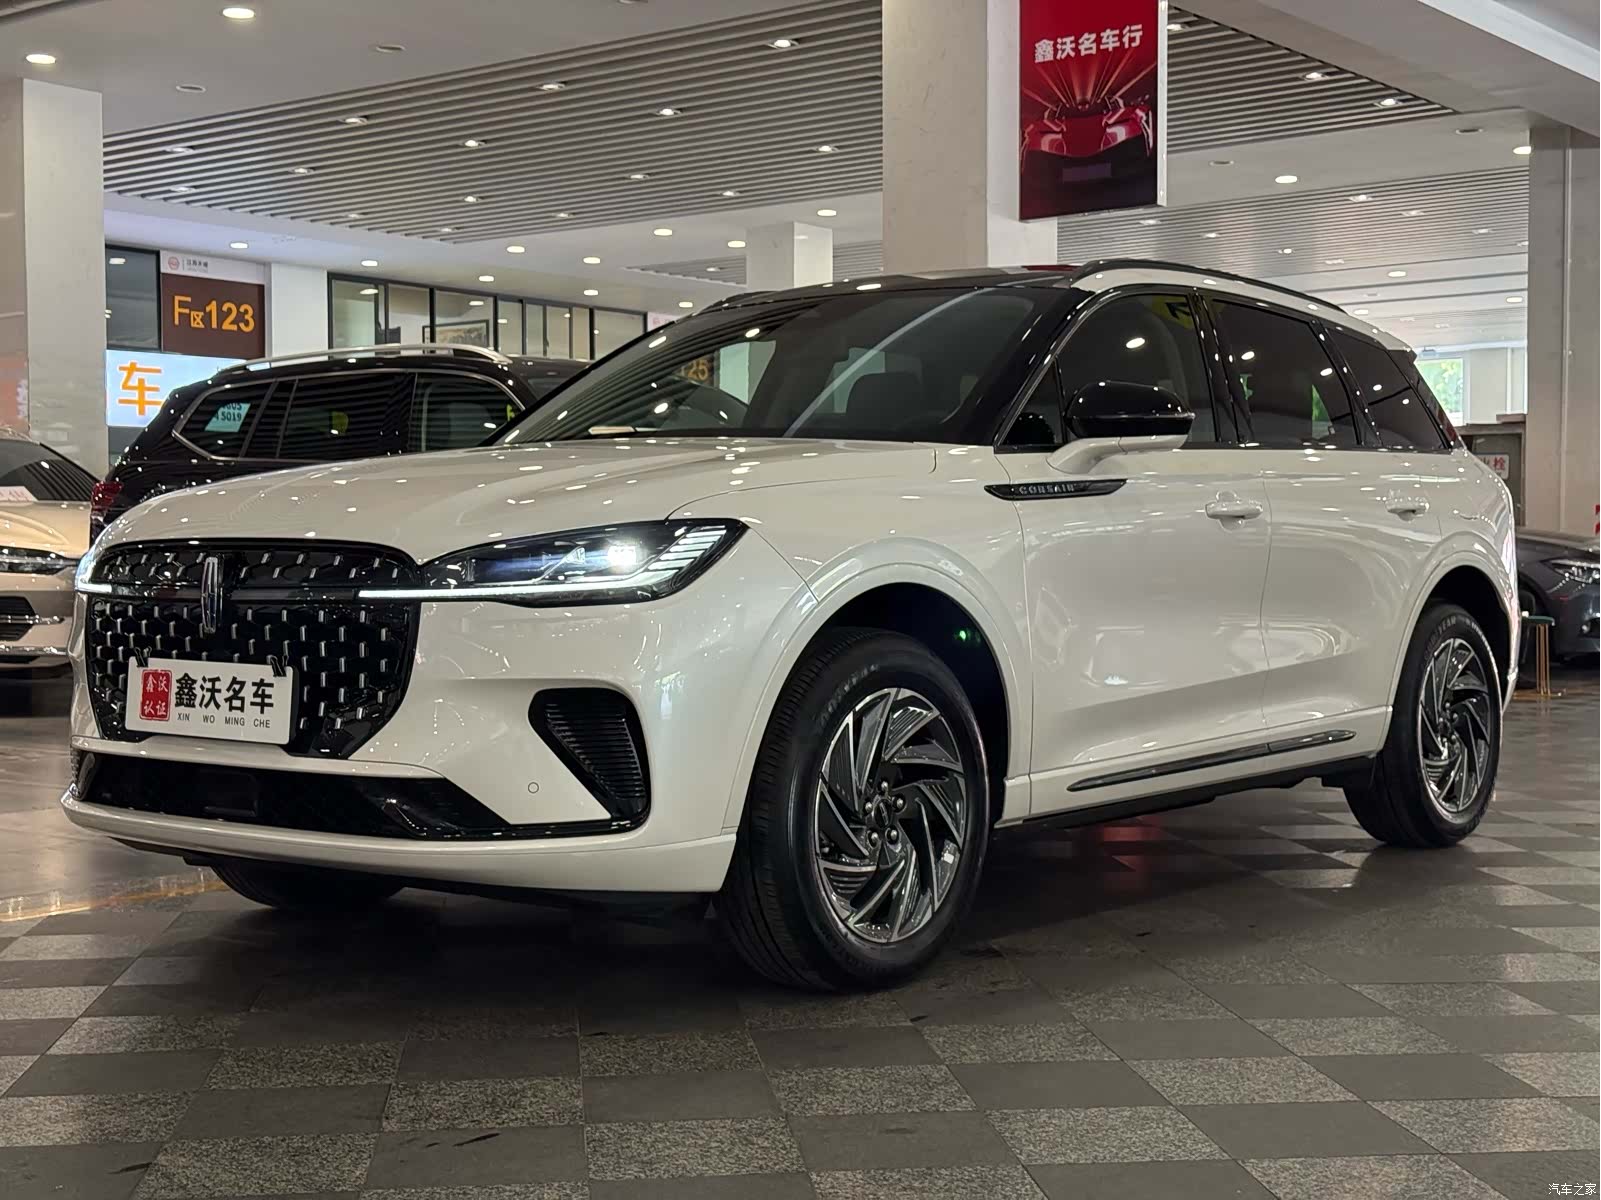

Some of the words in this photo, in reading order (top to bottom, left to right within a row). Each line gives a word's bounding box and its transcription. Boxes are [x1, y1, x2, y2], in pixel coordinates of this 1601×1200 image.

[1034, 24, 1143, 64] 鑫沃名车行
[172, 294, 255, 333] F区123
[118, 361, 162, 416] 车
[1018, 484, 1075, 495] CORSAIR
[143, 701, 167, 716] 认证
[174, 672, 275, 715] 鑫沃名车
[177, 712, 191, 721] XIN
[202, 714, 216, 724] WO
[224, 716, 245, 726] MING
[253, 718, 271, 728] CHE
